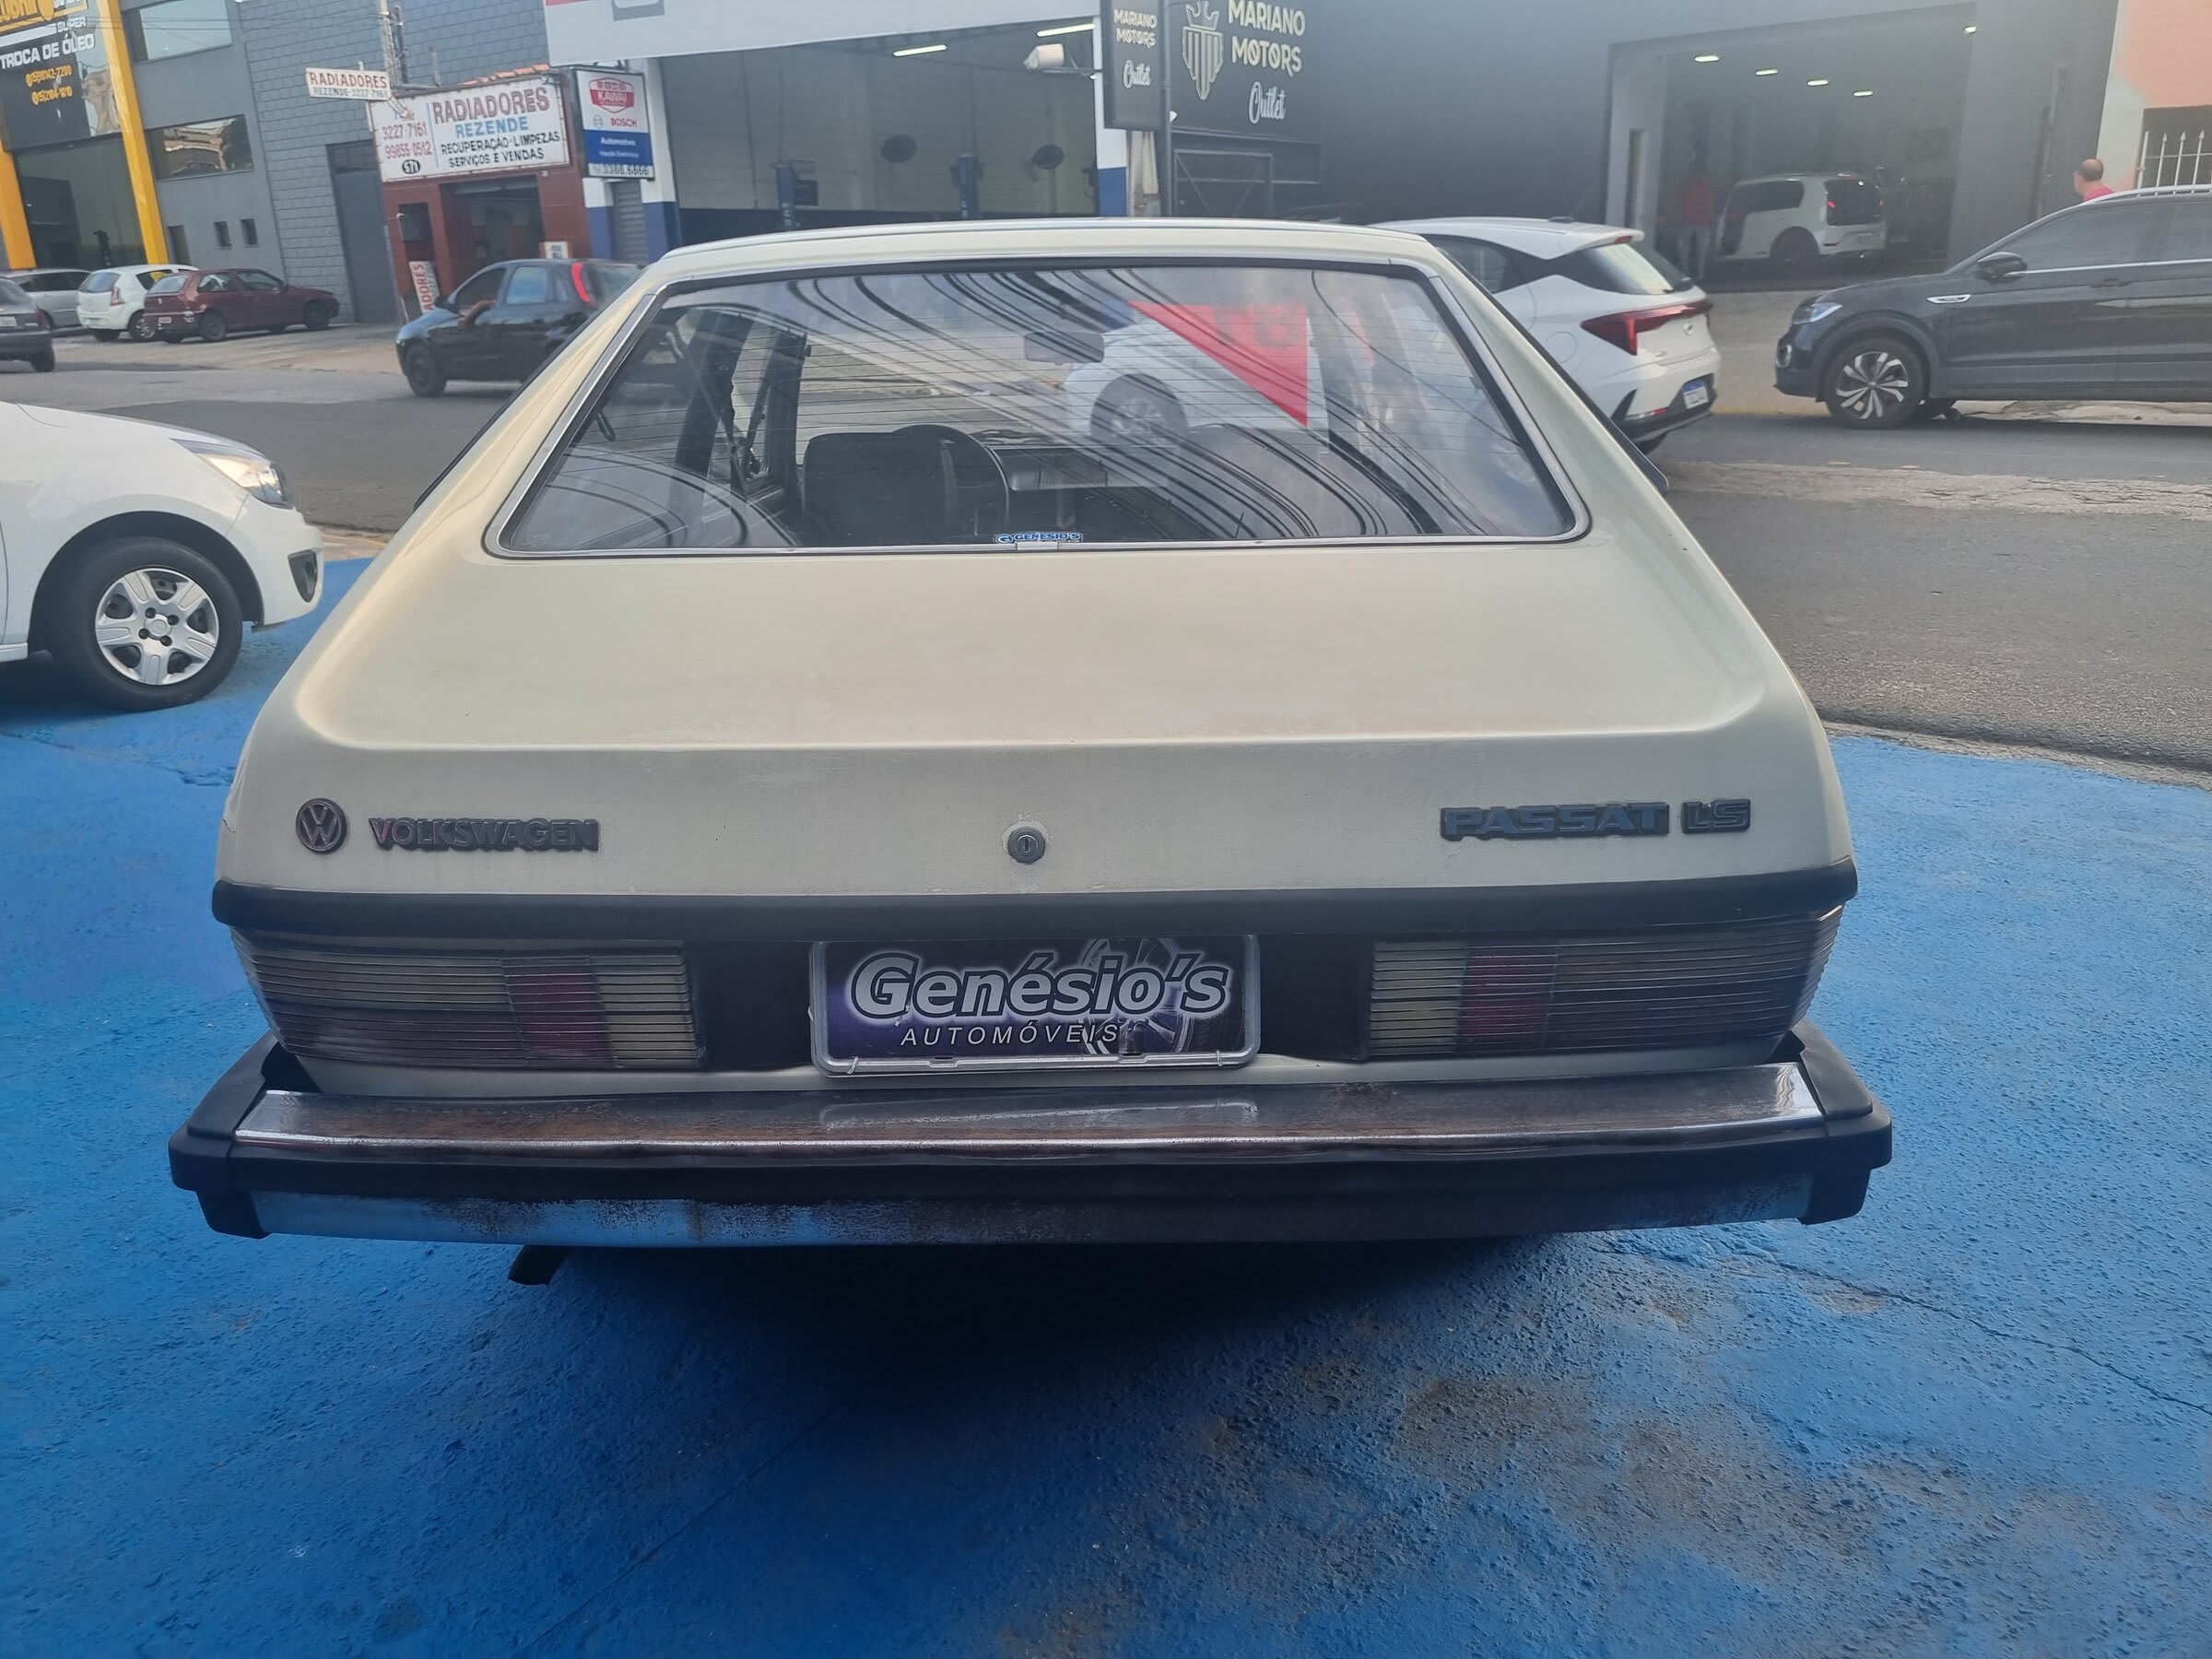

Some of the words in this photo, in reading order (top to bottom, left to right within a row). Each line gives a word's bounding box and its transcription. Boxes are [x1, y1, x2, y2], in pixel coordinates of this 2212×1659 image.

[1113, 8, 1158, 29] MARIANO
[1228, 0, 1305, 36] MARIANO
[0, 47, 41, 69] TROCA
[42, 41, 60, 60] DE
[63, 32, 95, 55] ÓLEO
[1116, 28, 1157, 49] MOTORS
[1231, 36, 1302, 76] MOTORS
[309, 72, 387, 89] RADIADORES
[1123, 59, 1151, 88] Outlet
[432, 87, 550, 124] RADIADORES
[1248, 81, 1287, 124] Outlet
[454, 116, 529, 139] REZENDE
[610, 117, 637, 127] BOSCH
[448, 153, 491, 168] SERVIÇOS
[493, 151, 500, 164] E
[500, 147, 545, 163] VENDAS
[369, 818, 598, 852] VOLKSWAGEN
[1441, 803, 1669, 840] PASSAT
[1682, 799, 1750, 834] LS
[850, 952, 1232, 1018] Genésio's
[900, 1020, 1122, 1046] AUTOMÓVEIS
